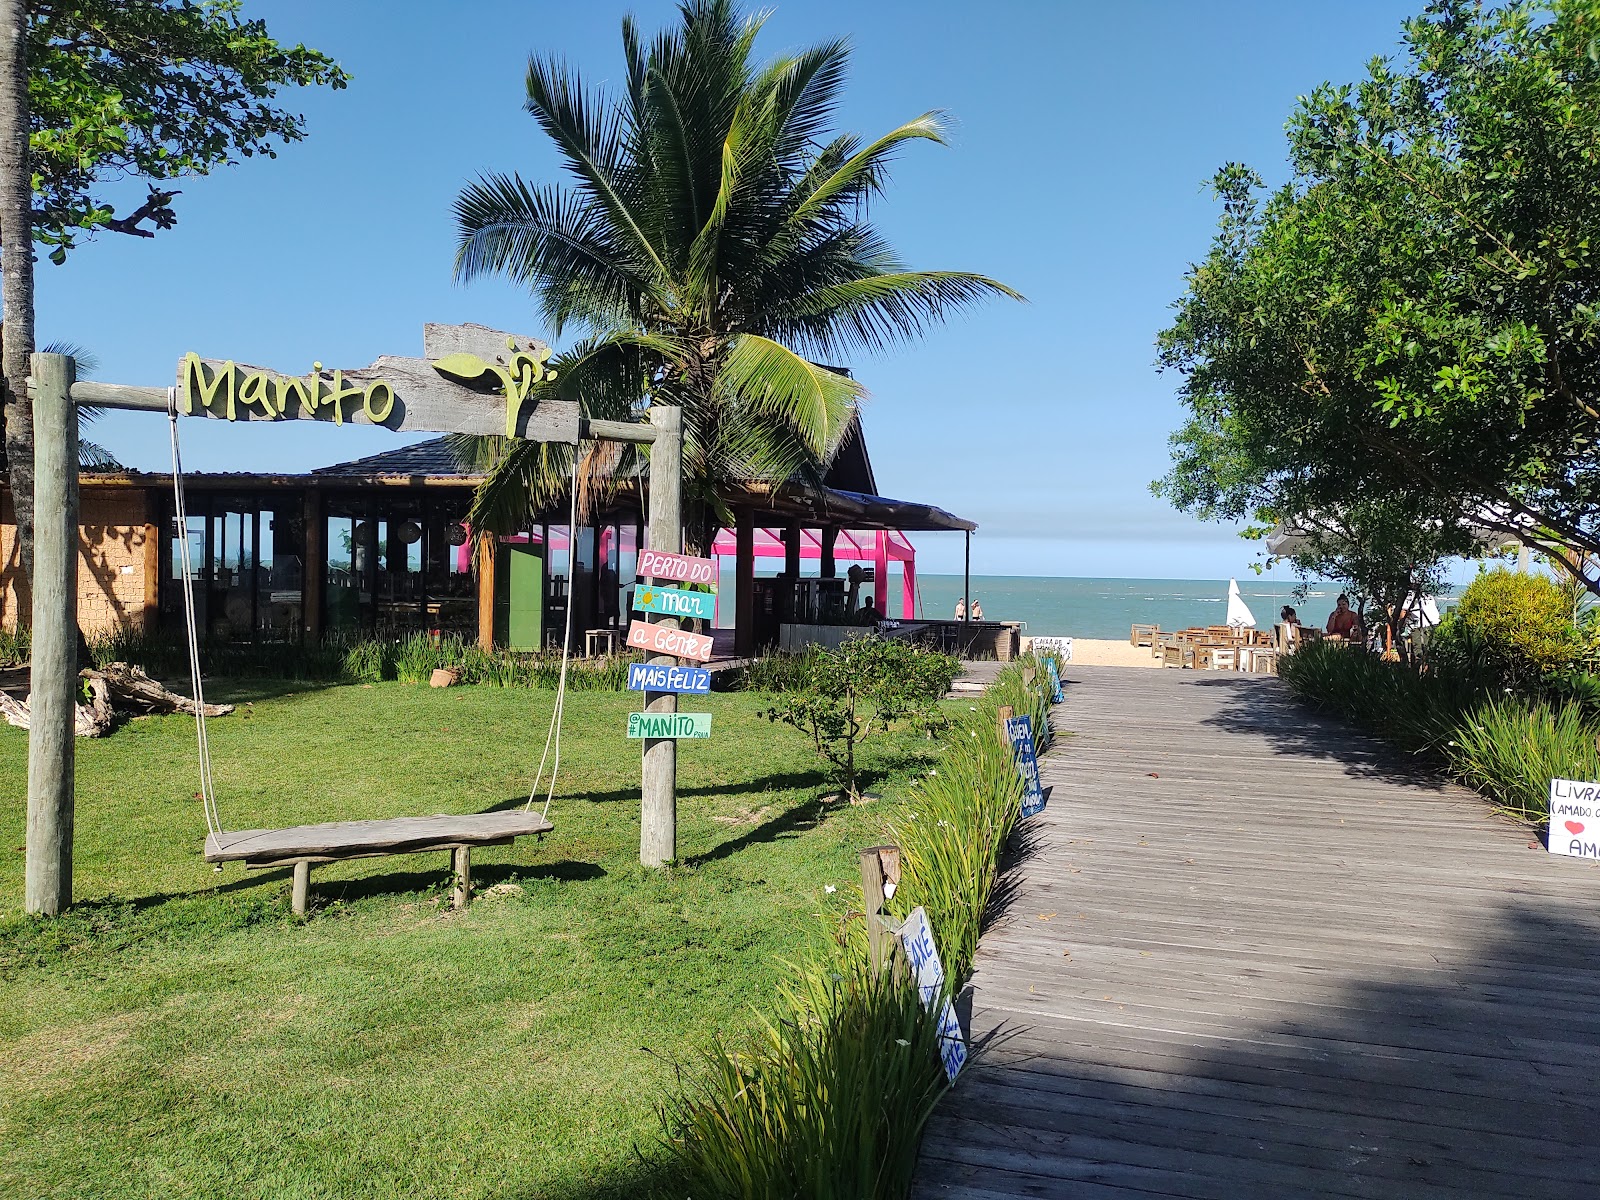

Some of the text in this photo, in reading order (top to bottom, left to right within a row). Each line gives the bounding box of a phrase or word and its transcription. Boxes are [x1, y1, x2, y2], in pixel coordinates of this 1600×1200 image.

[184, 351, 395, 427] Manito
[640, 552, 712, 582] PERTO DO
[633, 628, 650, 644] a
[1569, 839, 1600, 858] AM
